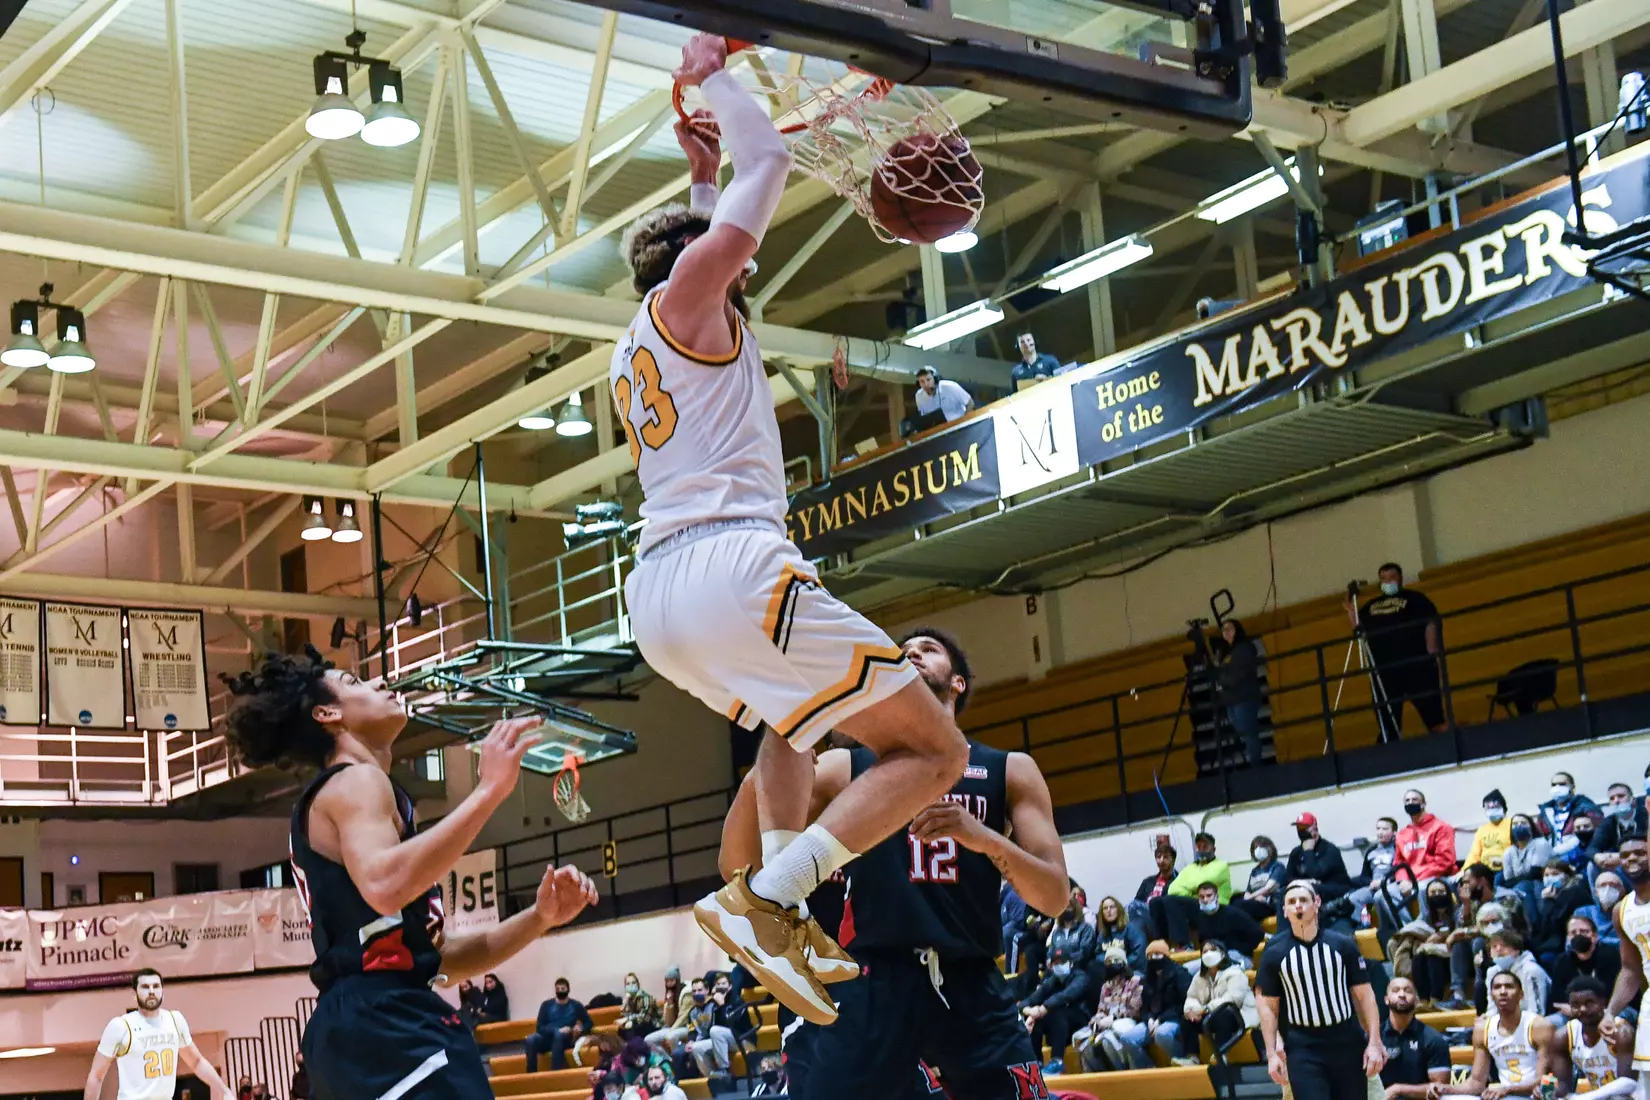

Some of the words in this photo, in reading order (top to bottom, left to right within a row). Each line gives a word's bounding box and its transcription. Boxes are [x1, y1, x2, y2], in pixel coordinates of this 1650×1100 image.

[1185, 184, 1619, 407] MARAUDERS
[1096, 367, 1161, 410] Home
[1101, 416, 1124, 443] of
[1129, 403, 1164, 434] the
[1010, 408, 1058, 473] M
[69, 608, 119, 617] TOURNAMENT
[130, 612, 149, 620] NCAA
[150, 614, 199, 622] TOURNAMENT
[71, 615, 96, 646] M
[153, 621, 178, 651] M
[142, 651, 192, 661] WRESTLING
[909, 832, 959, 883] 12
[40, 915, 118, 940] UPMC
[41, 938, 130, 966] Pinnacle
[143, 1047, 174, 1079] 20
[1506, 1058, 1523, 1083] 5
[1006, 1060, 1050, 1100] M
